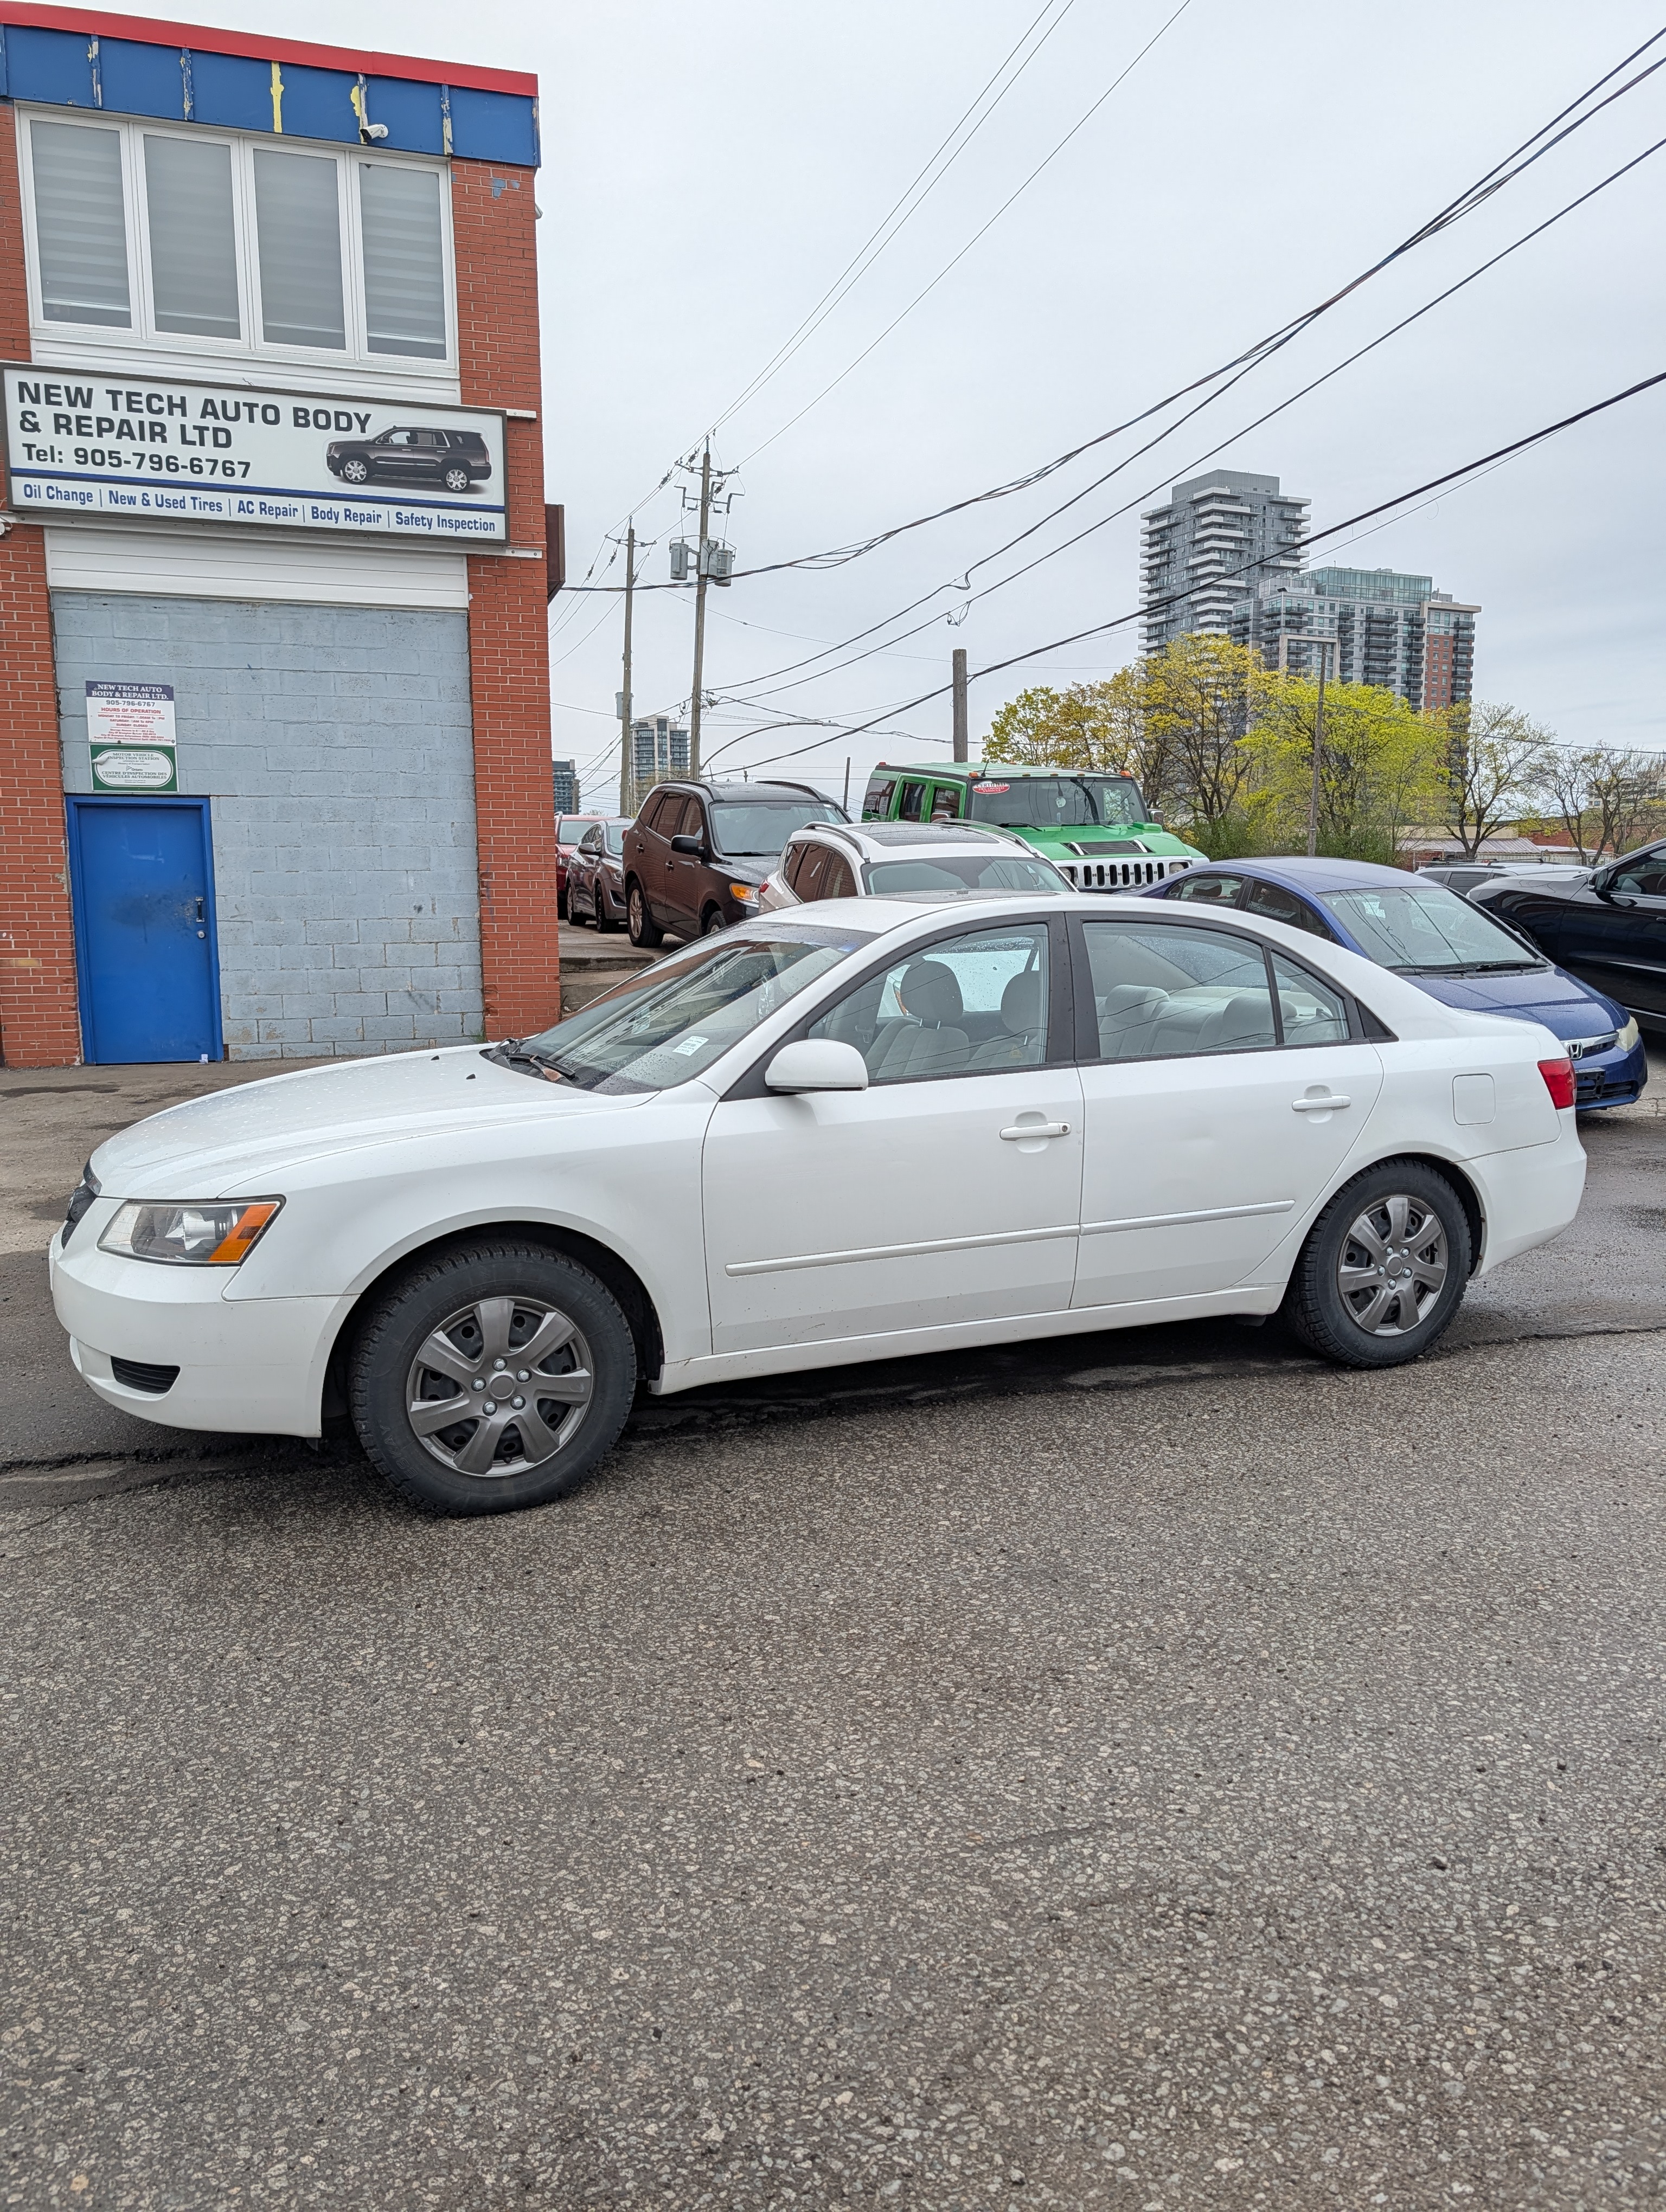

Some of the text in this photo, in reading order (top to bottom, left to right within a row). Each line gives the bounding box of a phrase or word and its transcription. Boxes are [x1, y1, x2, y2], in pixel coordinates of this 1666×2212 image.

[18, 381, 372, 434] NEW TECH AUTO BODY
[20, 410, 232, 449] & REPAIR LTD
[22, 442, 251, 479] Tel: 905-796-6767
[23, 484, 496, 533] Oil Change New & Used Tires AC Repair Body Repair Safety Inspection
[380, 1424, 419, 1480] ESKAY
